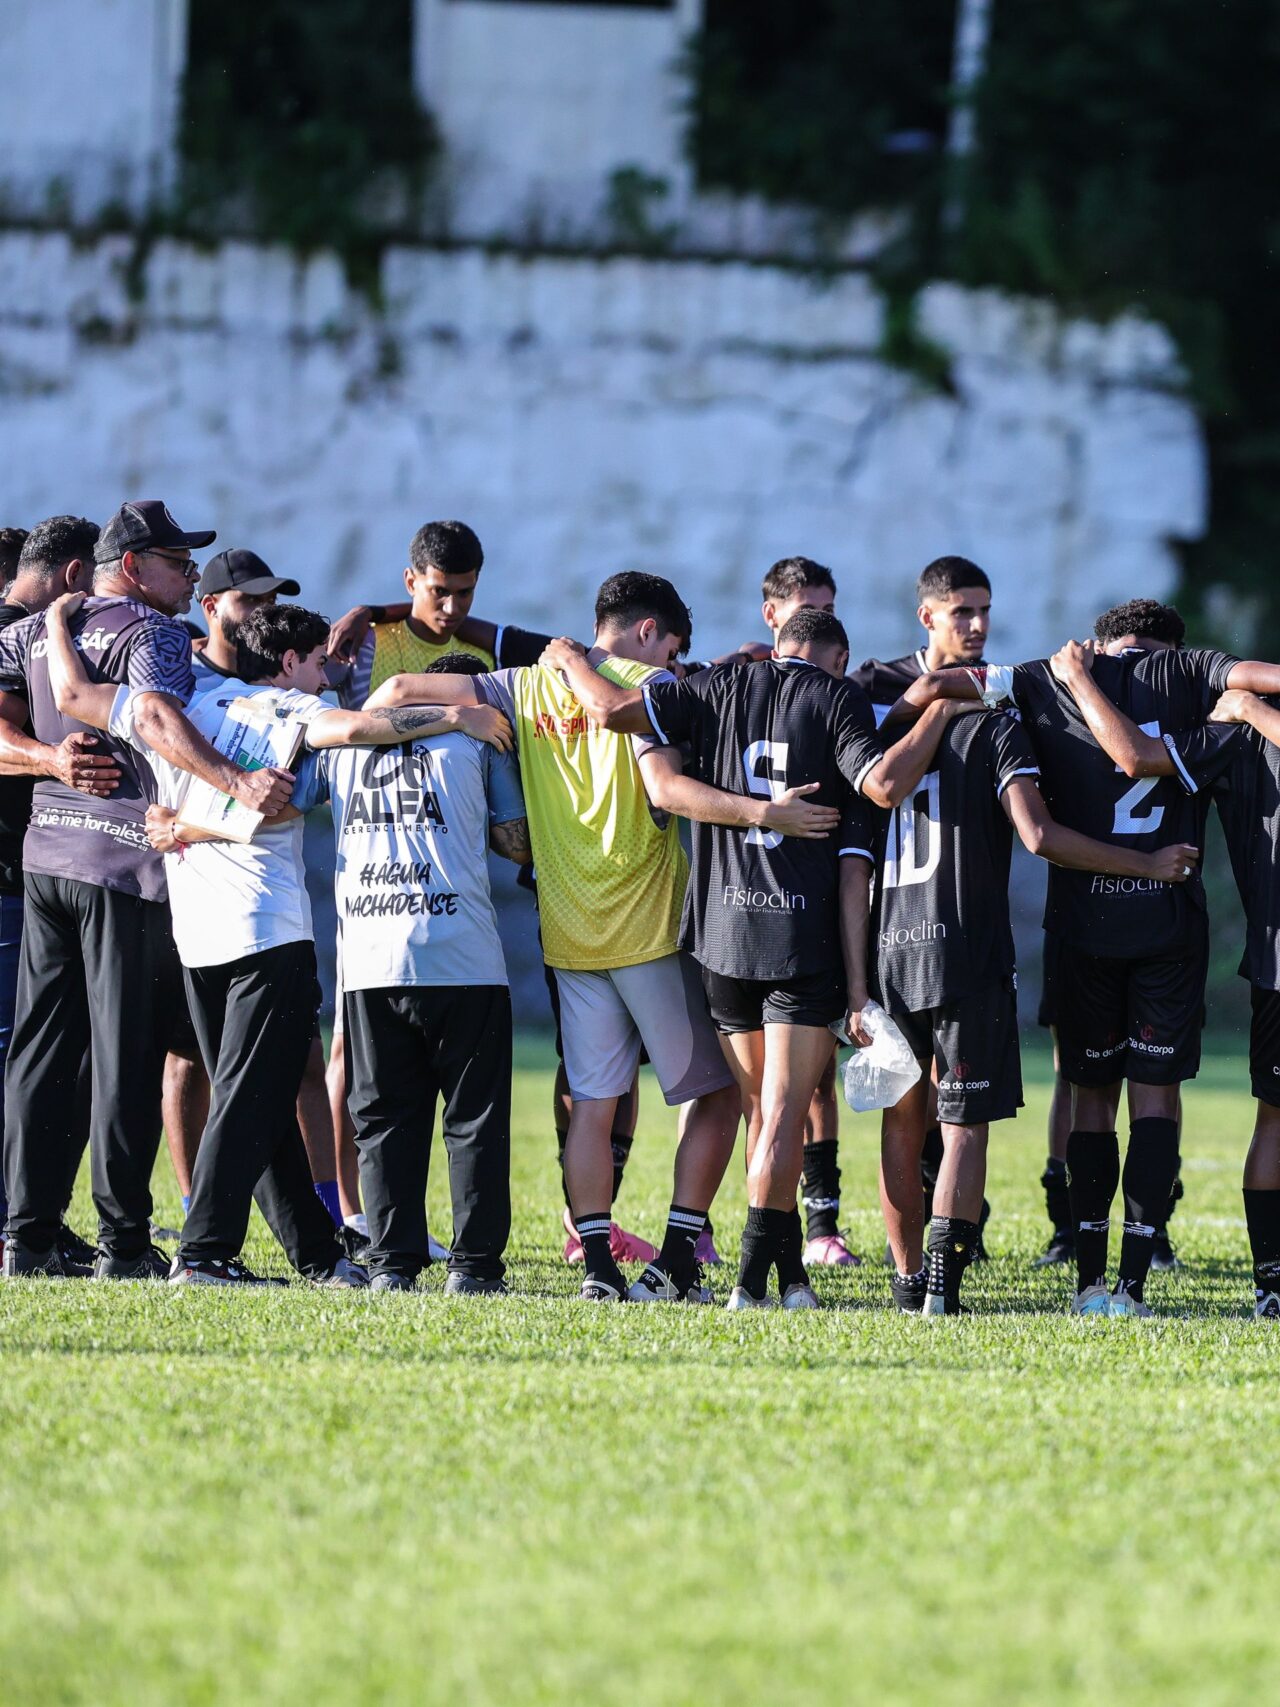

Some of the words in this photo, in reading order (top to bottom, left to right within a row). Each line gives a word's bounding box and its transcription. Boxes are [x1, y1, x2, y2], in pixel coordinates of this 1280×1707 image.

[1112, 721, 1165, 834] 2
[346, 790, 446, 826] ALFA
[37, 813, 60, 828] que
[61, 815, 82, 827] me
[84, 814, 151, 846] fortalece
[344, 824, 448, 836] GERENCIAMENTO
[360, 856, 431, 889] #ÁGUIA
[723, 885, 806, 910] Fisioclin
[878, 919, 946, 949] isioclin
[1085, 1049, 1100, 1059] Cia
[1102, 1049, 1114, 1058] do
[1147, 1045, 1174, 1056] corpo
[940, 1080, 950, 1090] Cia
[952, 1080, 964, 1090] do
[966, 1080, 989, 1091] corpo
[583, 1288, 600, 1296] AIR
